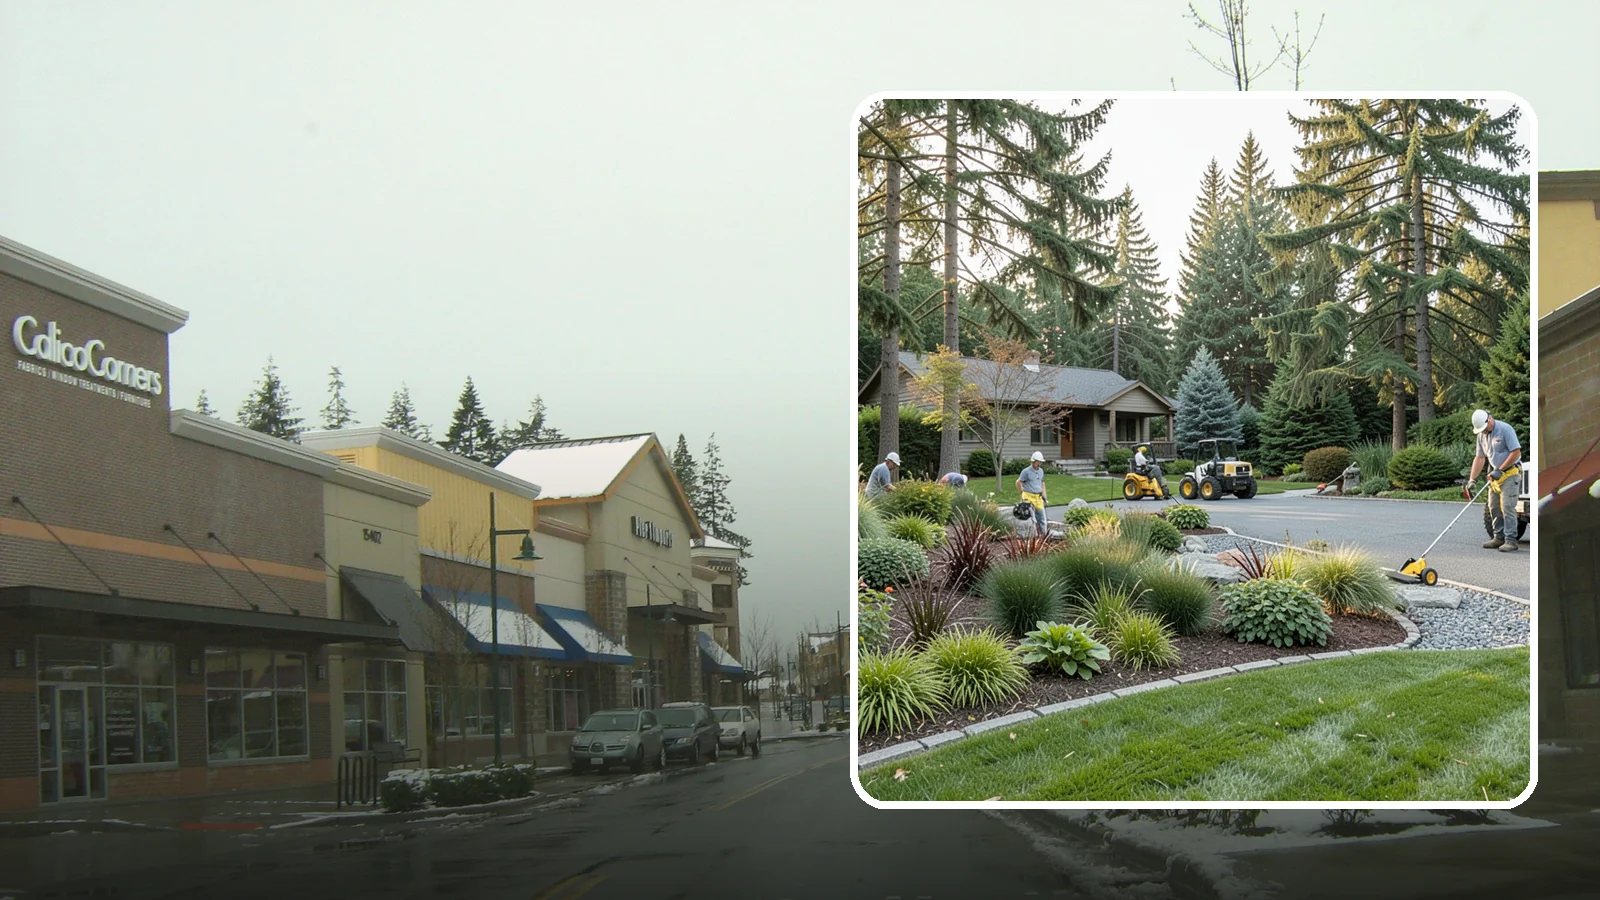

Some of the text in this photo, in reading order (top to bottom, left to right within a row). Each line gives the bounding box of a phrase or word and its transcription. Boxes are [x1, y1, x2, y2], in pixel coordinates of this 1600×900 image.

[17, 359, 47, 378] FABRICS
[51, 370, 78, 386] WINDOW
[79, 378, 117, 398] TREATMENTS
